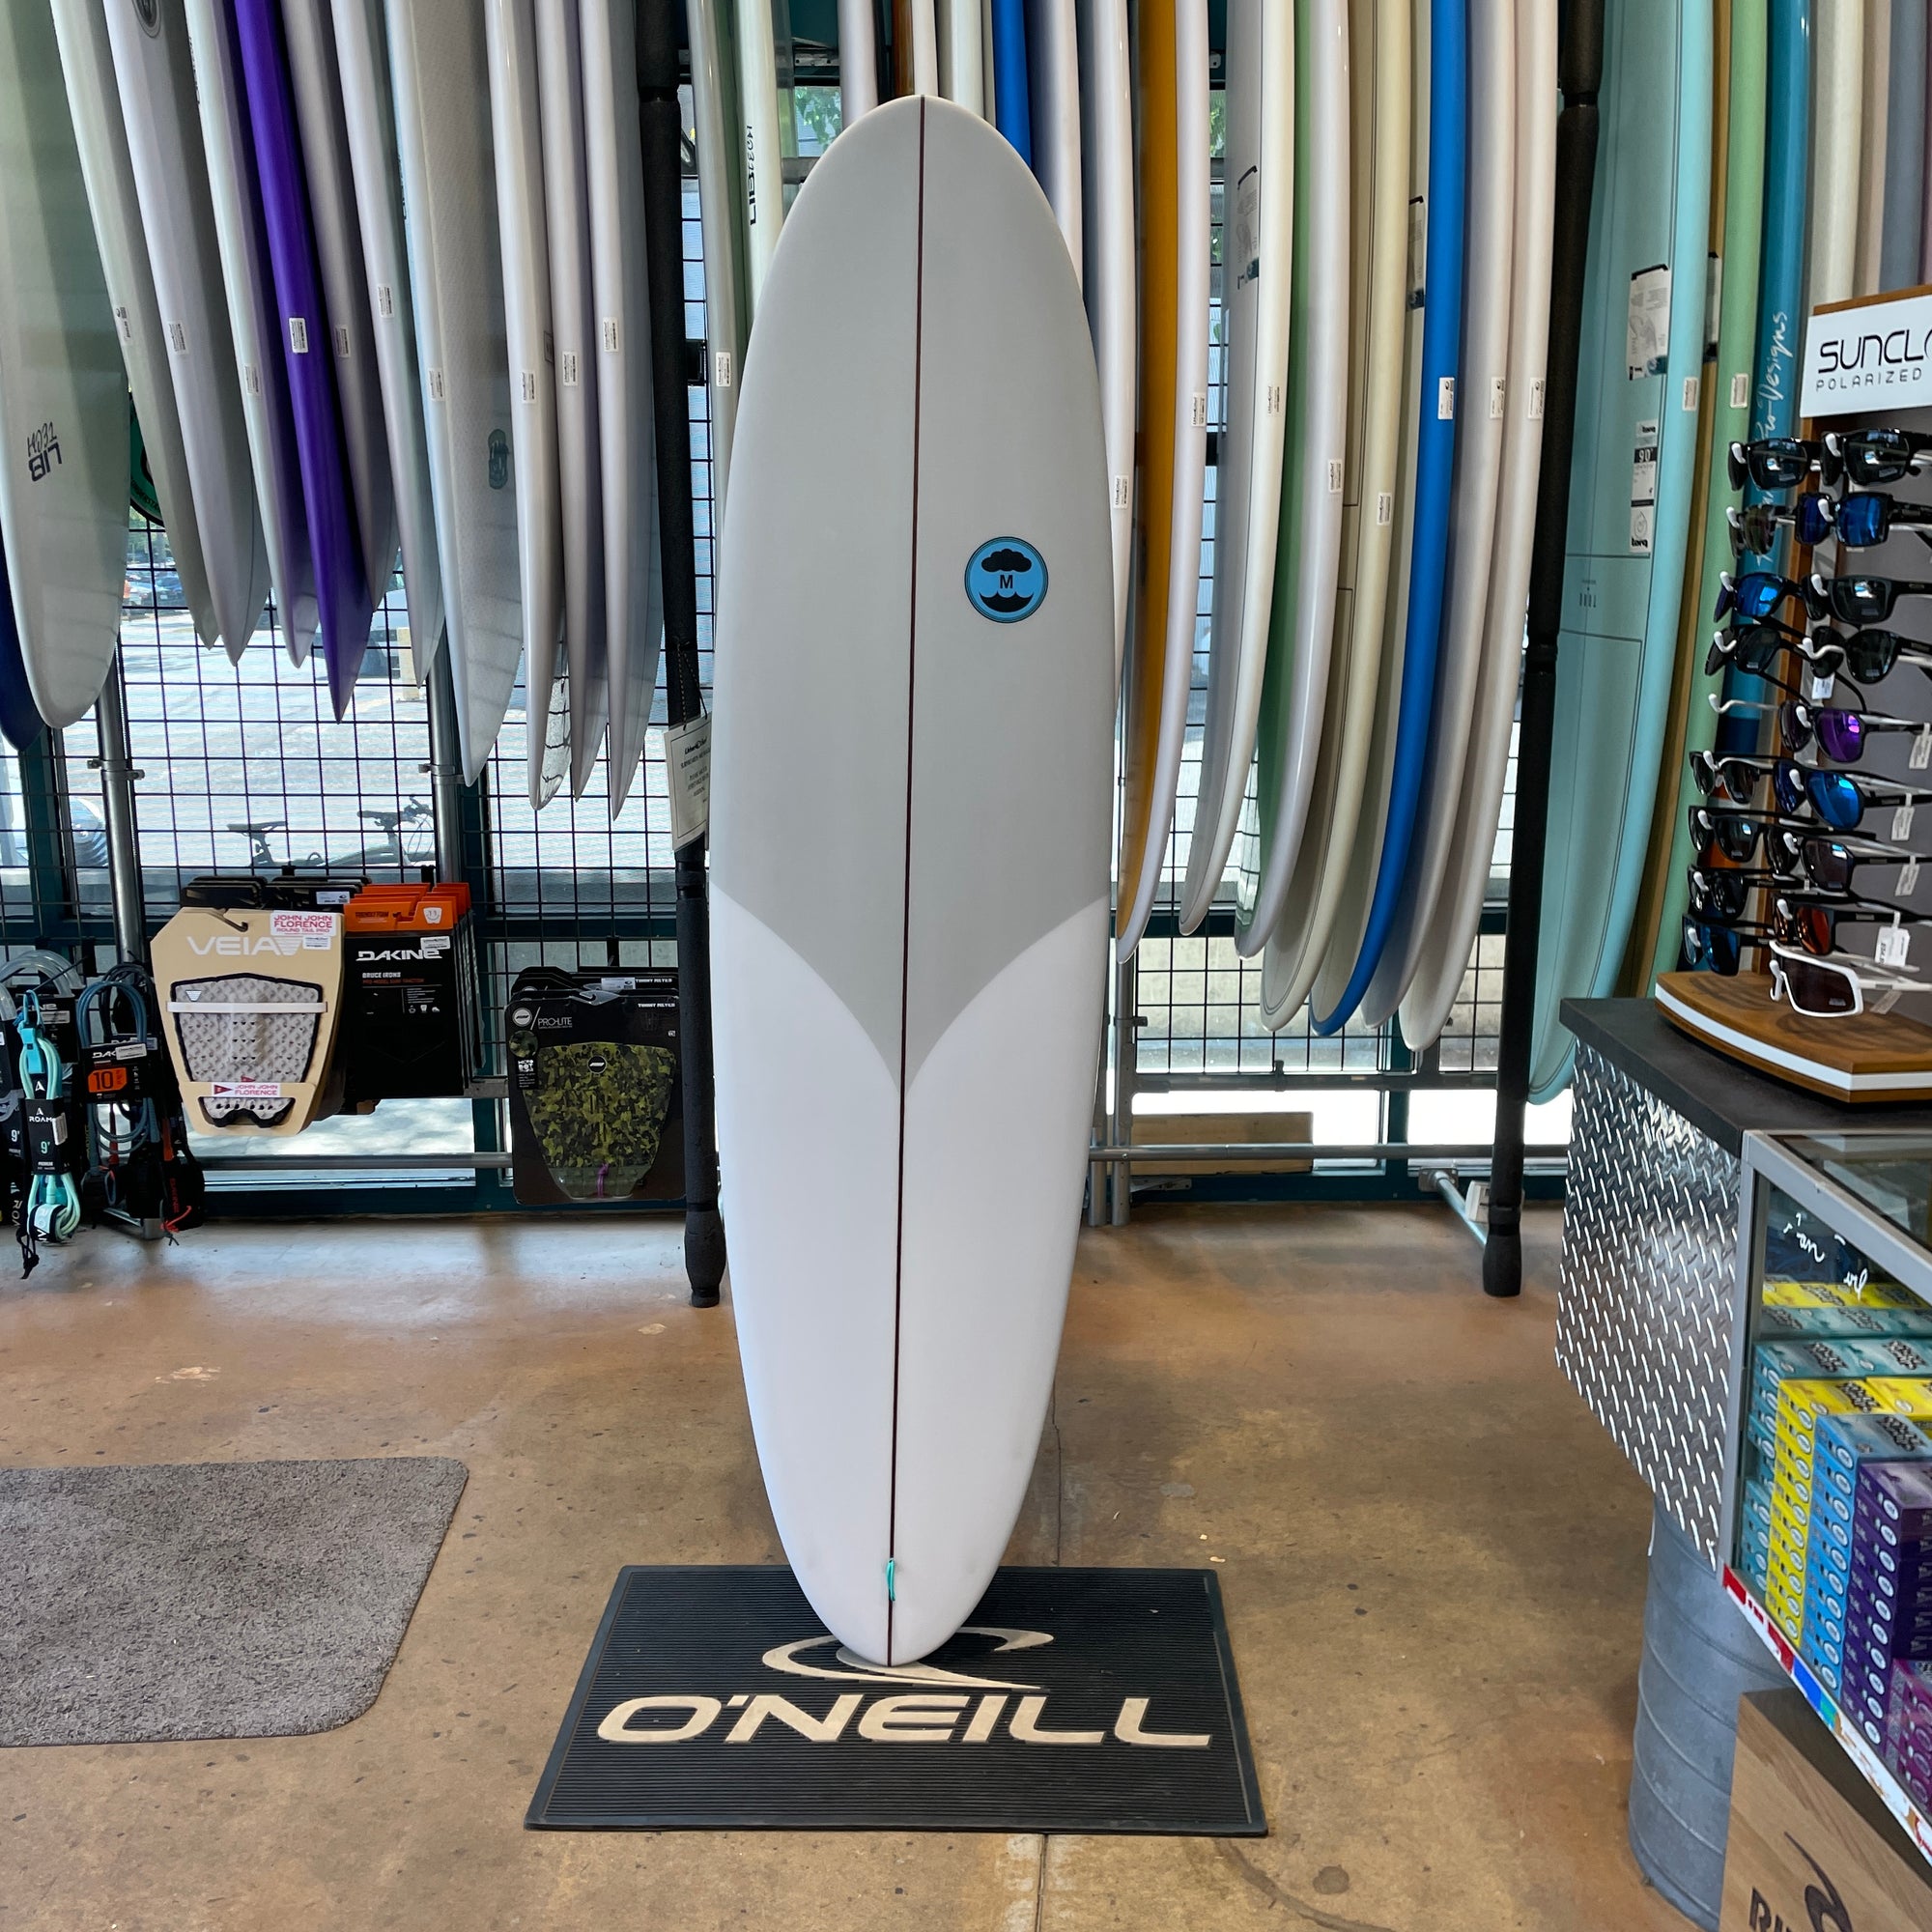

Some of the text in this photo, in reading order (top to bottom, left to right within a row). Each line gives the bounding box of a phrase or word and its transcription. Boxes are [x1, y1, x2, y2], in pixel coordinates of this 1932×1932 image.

[1818, 328, 1932, 374] SUNCL
[1816, 367, 1922, 391] POLARIZED
[28, 441, 62, 482] LIB
[1000, 574, 1013, 589] M
[186, 936, 281, 955] VEIA
[355, 950, 442, 961] DAKINE
[596, 1693, 1211, 1747] O'NEILL
